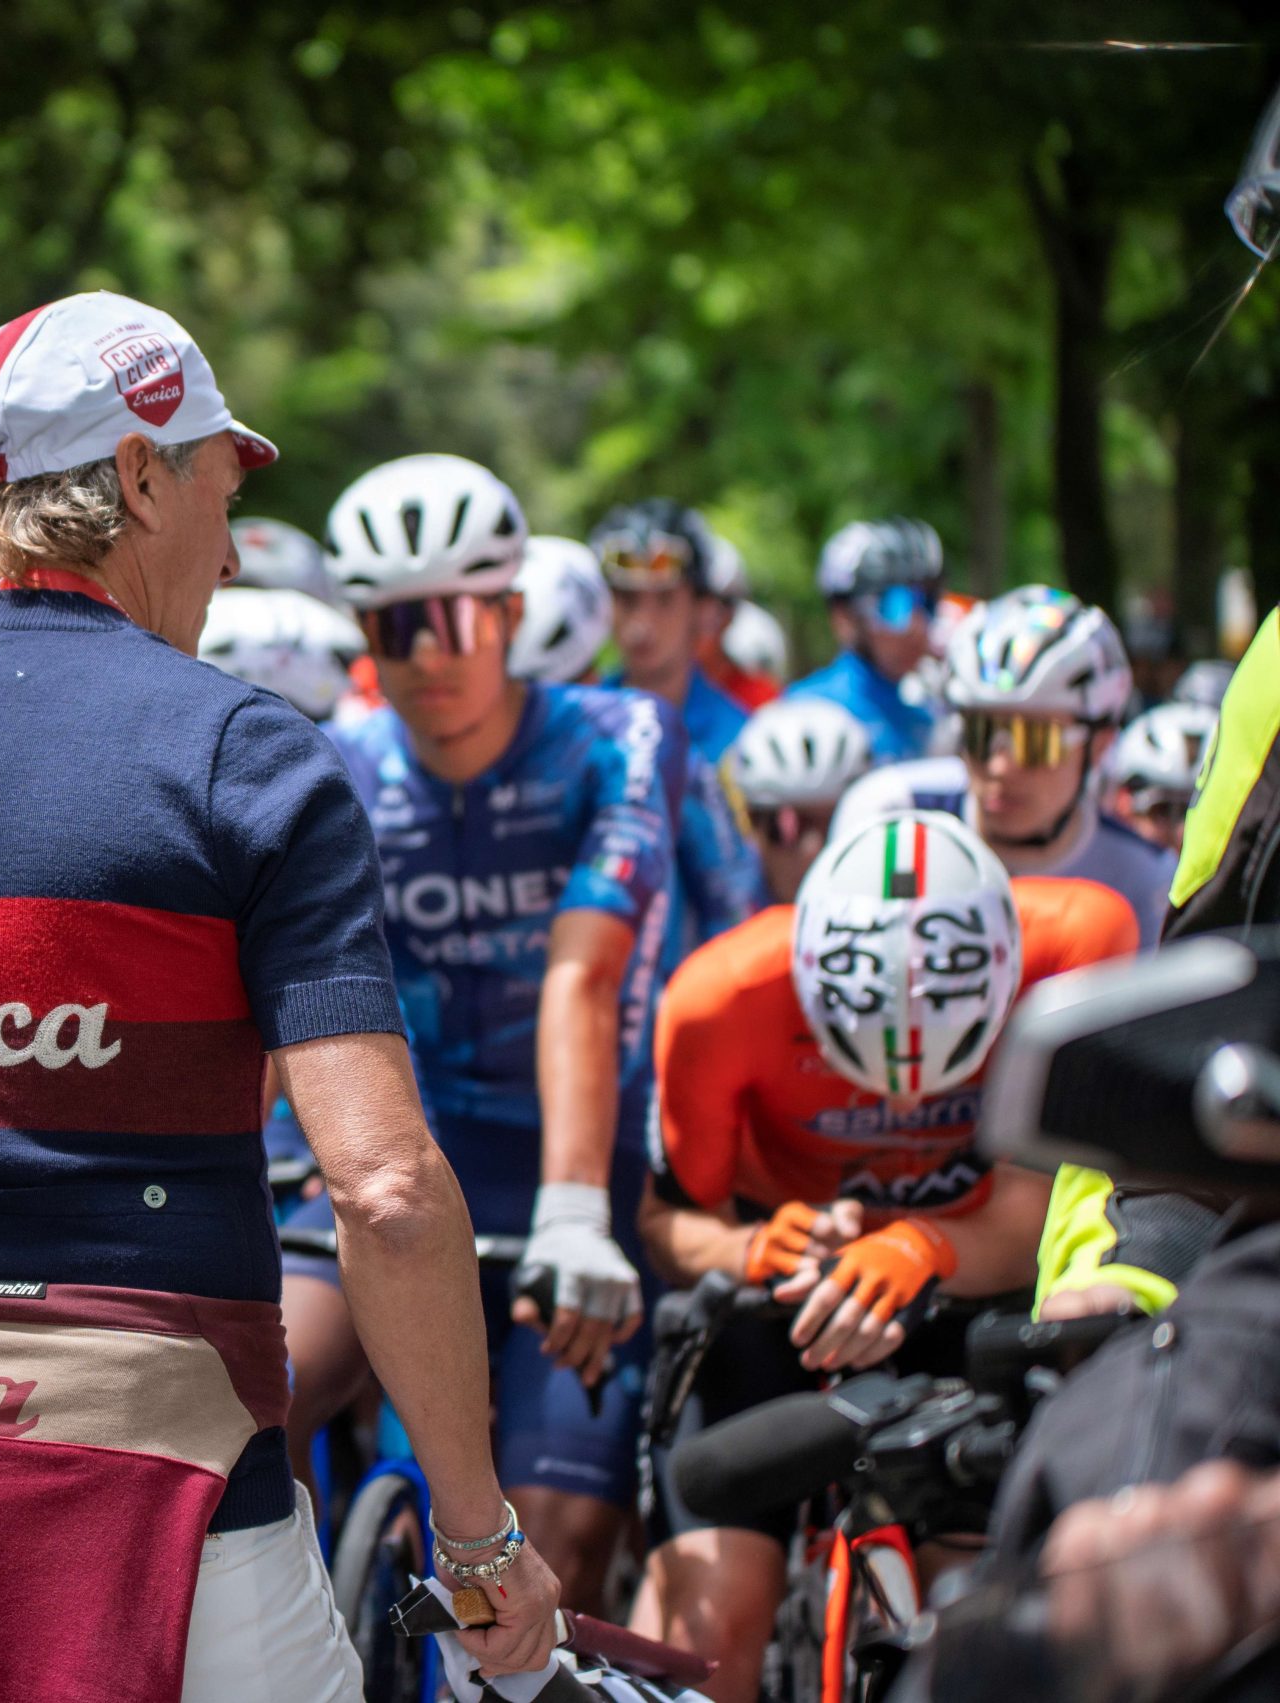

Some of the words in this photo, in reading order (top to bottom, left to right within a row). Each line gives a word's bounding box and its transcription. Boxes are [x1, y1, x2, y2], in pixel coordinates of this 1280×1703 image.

[111, 338, 164, 368] CICLO
[126, 354, 171, 386] CLUB
[132, 384, 181, 407] Eroica
[819, 916, 887, 1016] 162
[915, 908, 991, 1012] 162
